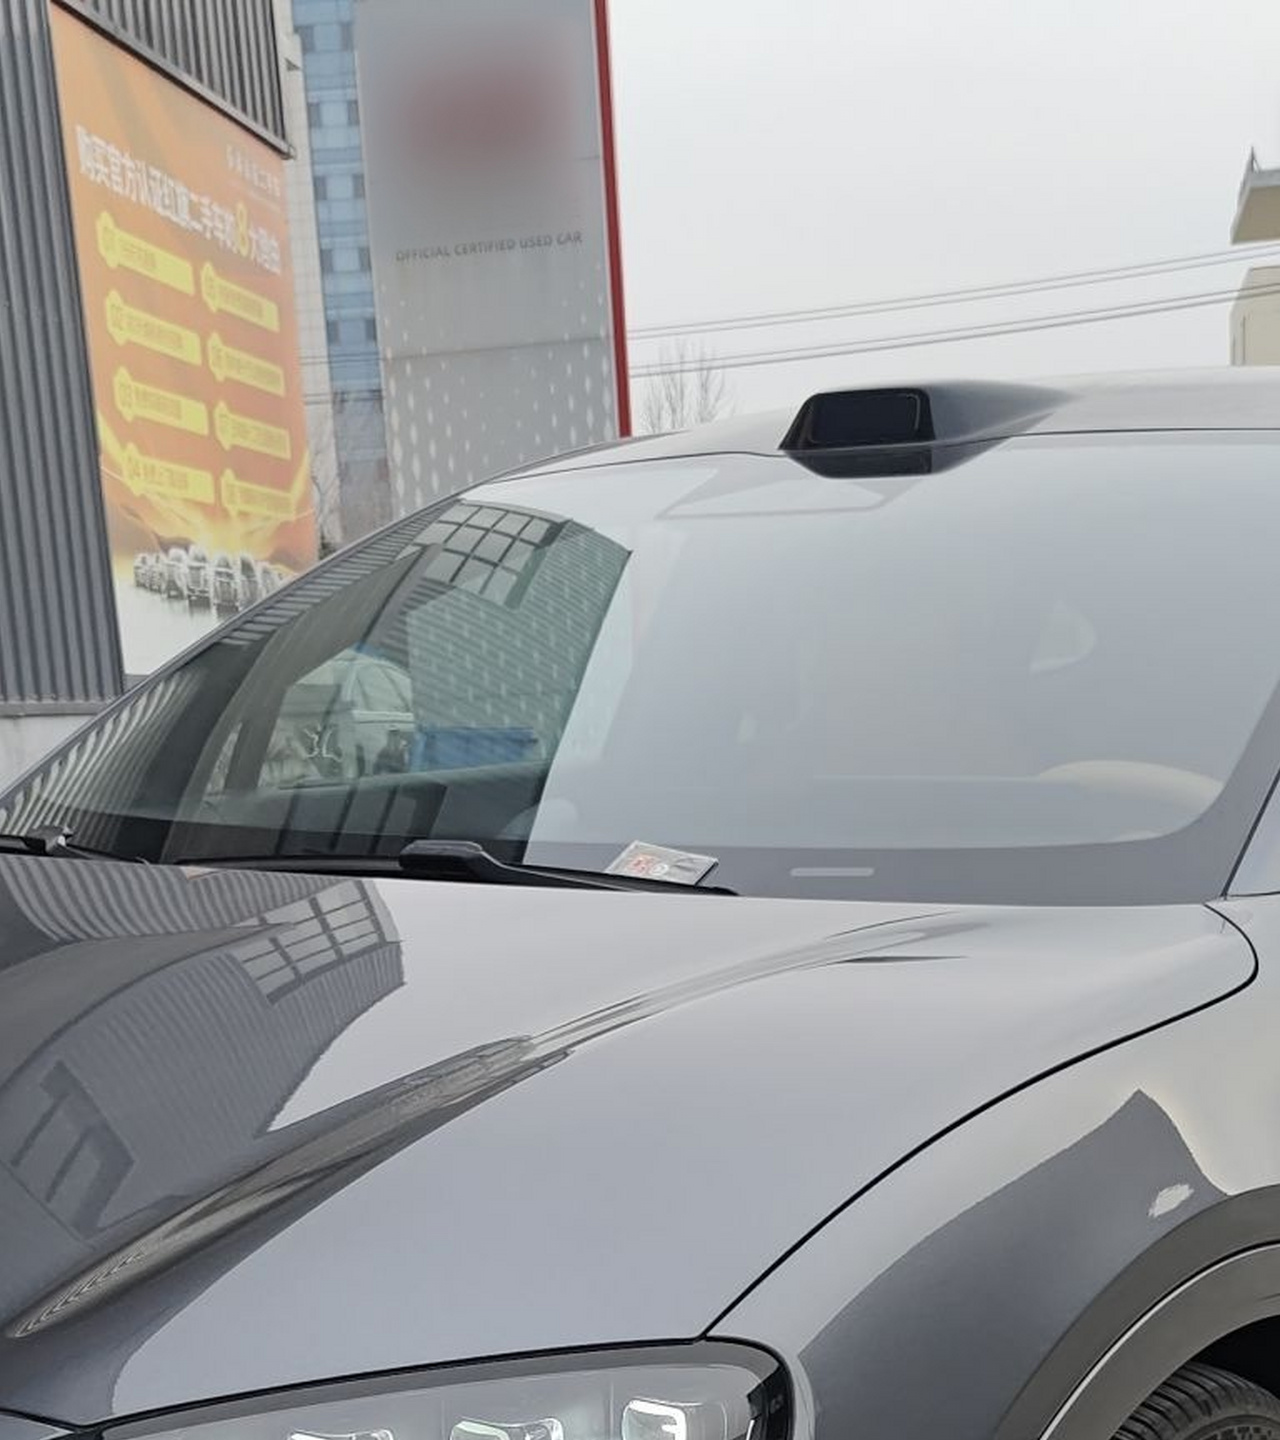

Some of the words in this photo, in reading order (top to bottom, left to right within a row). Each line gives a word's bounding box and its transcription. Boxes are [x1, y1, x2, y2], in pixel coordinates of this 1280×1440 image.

[395, 245, 450, 262] OFFICIAL
[454, 238, 516, 257] CERTIFIED
[520, 234, 553, 250] USED
[557, 230, 583, 246] CAR
